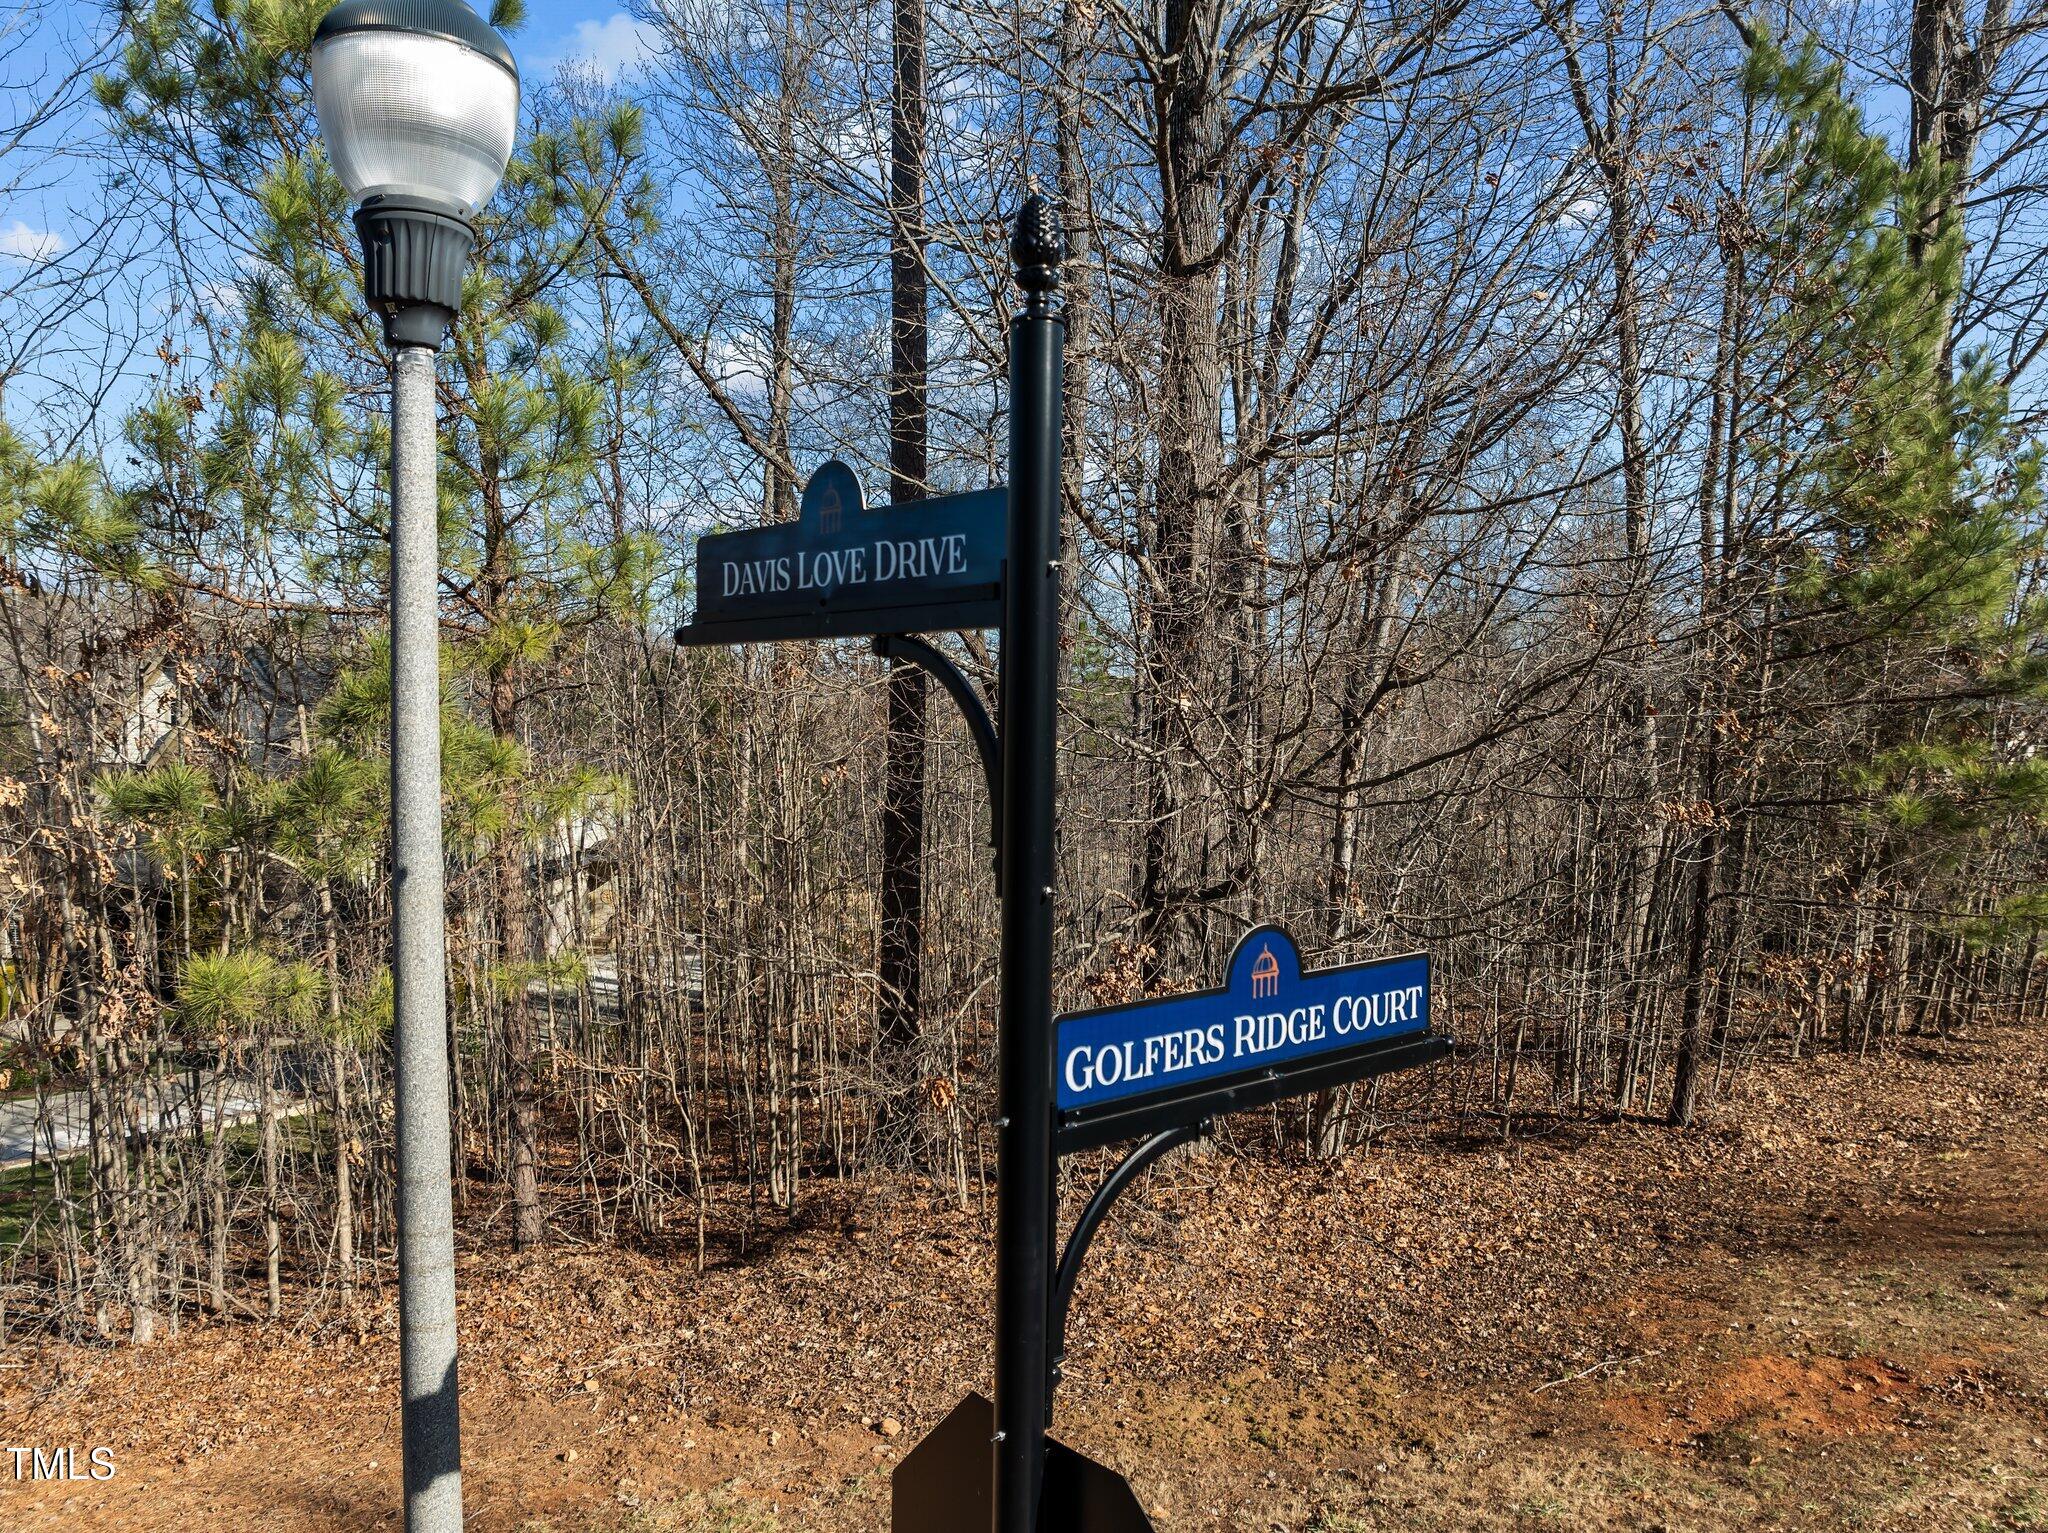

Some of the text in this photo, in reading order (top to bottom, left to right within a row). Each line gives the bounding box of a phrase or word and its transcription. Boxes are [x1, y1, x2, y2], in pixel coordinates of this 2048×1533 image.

[722, 534, 967, 597] DAVIS LOVE DRIVE
[1065, 985, 1423, 1093] GOLFERS RIDGE COURT
